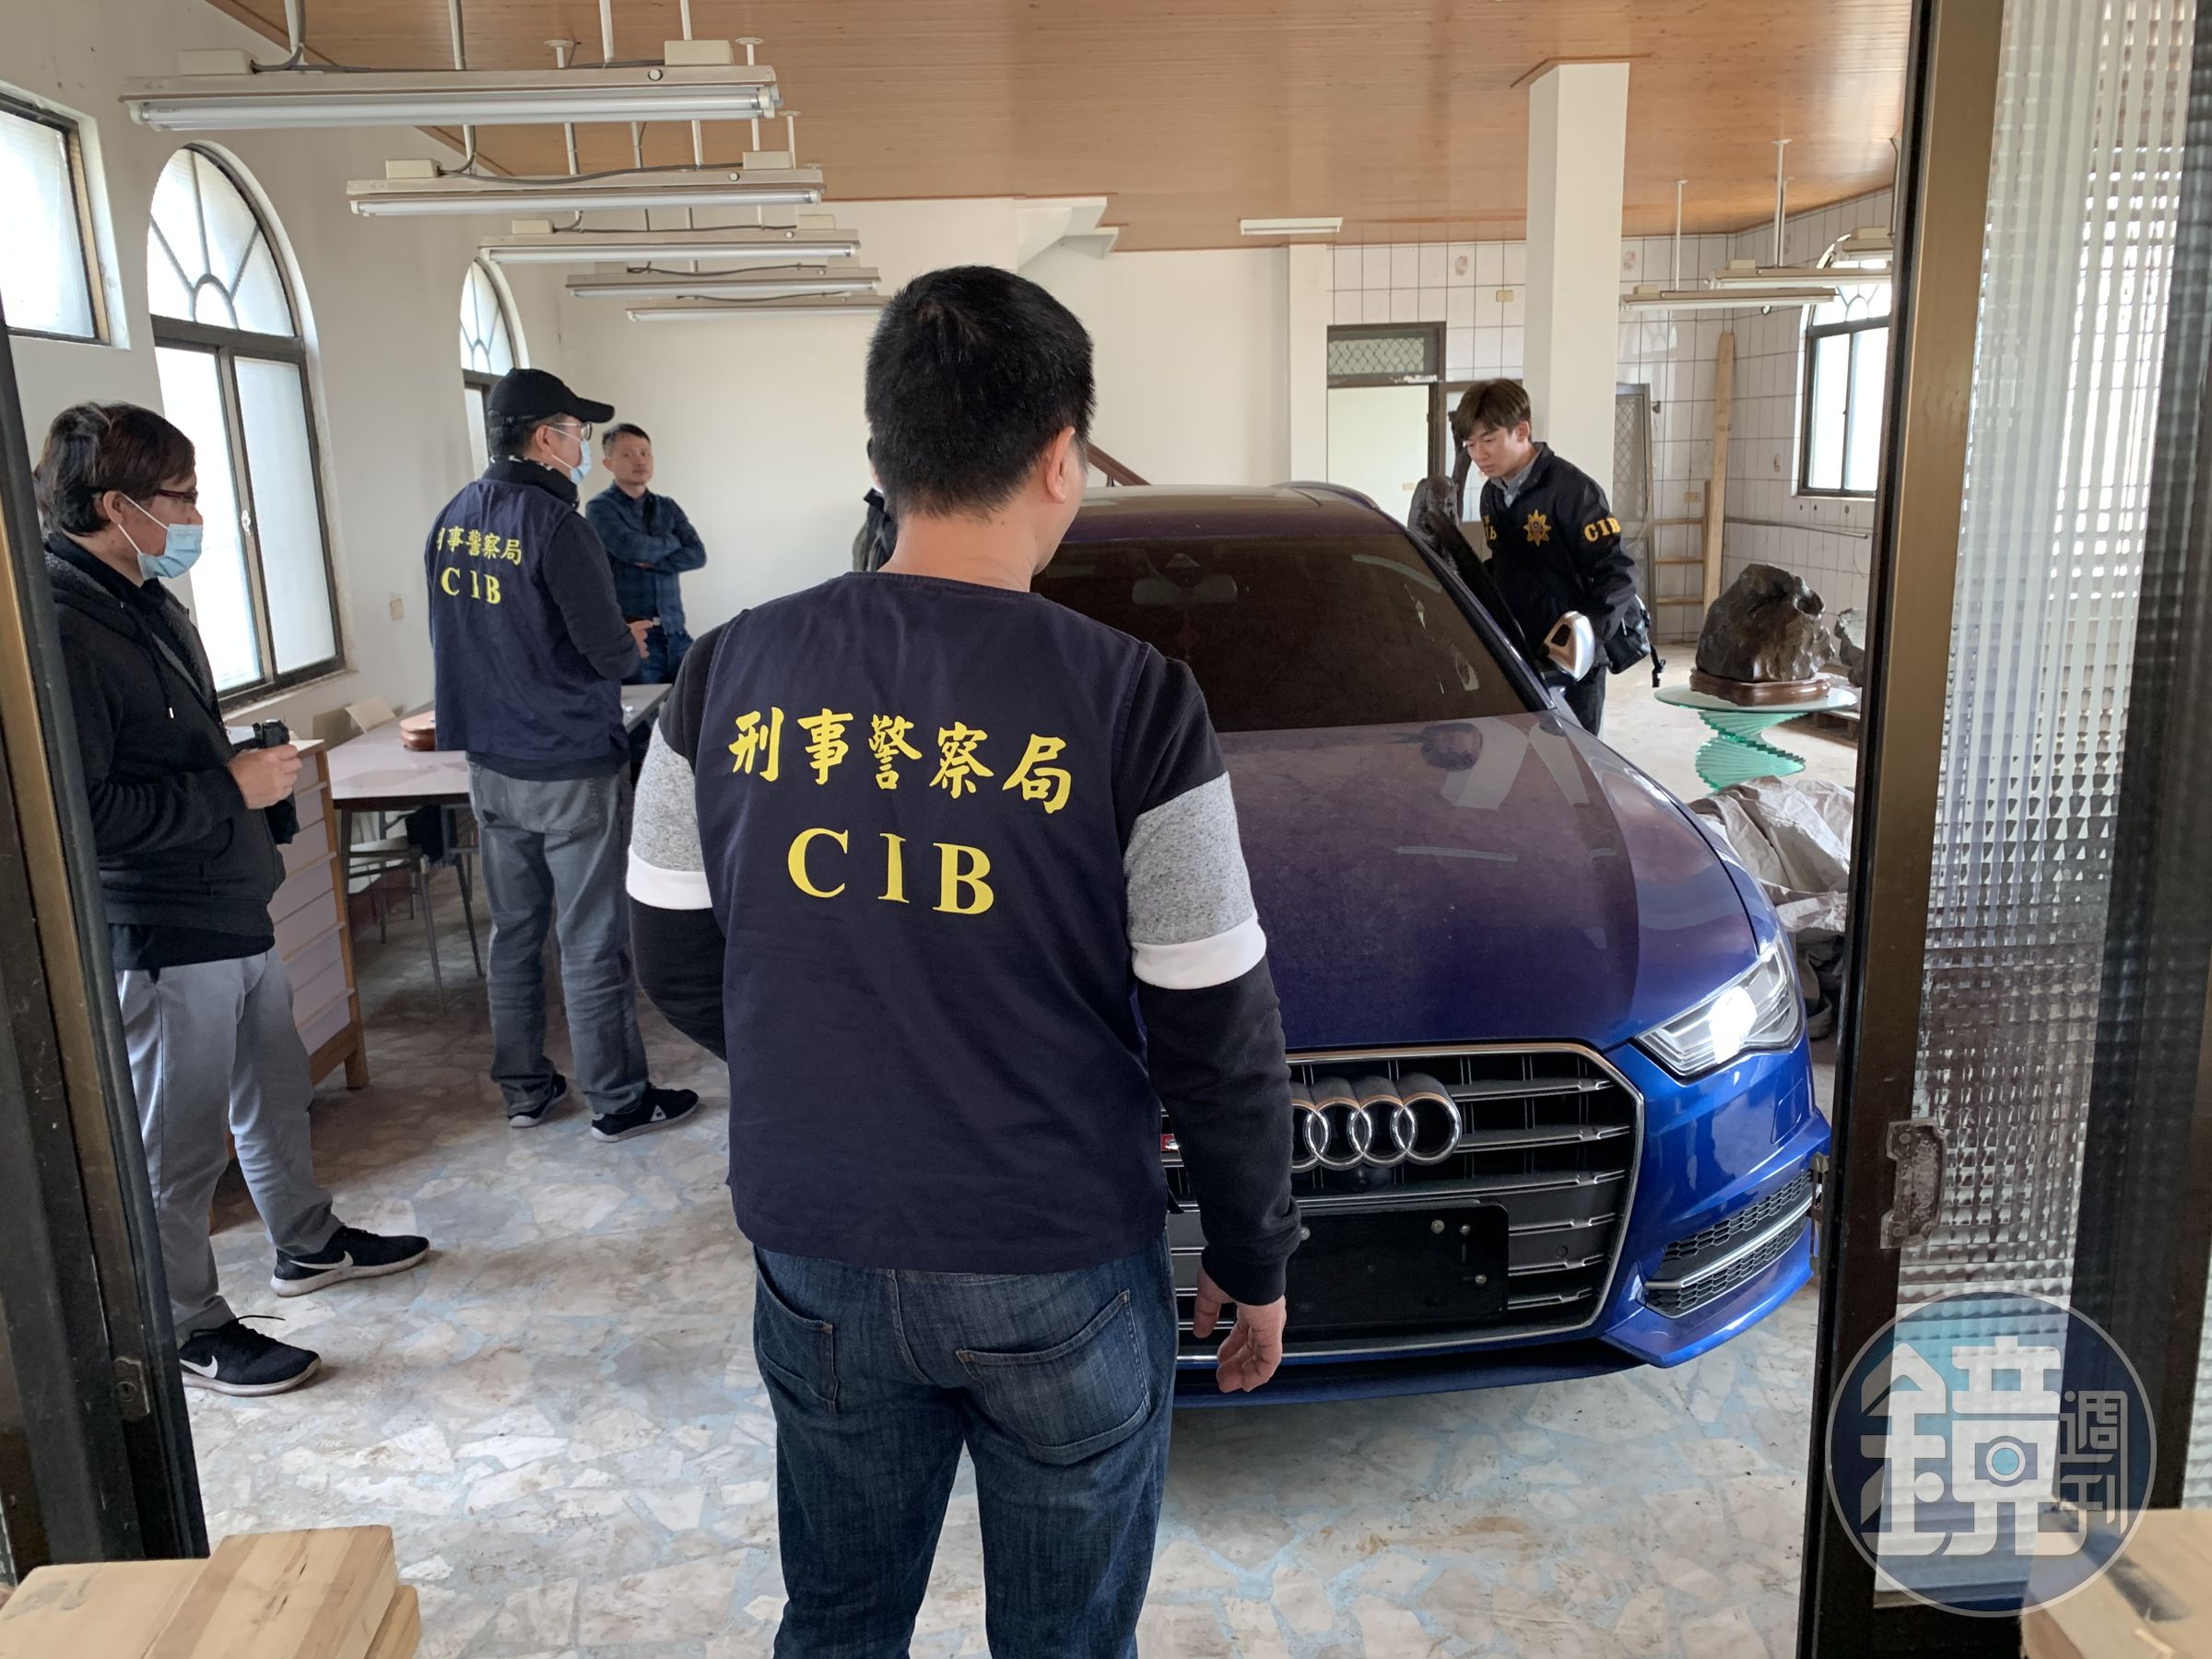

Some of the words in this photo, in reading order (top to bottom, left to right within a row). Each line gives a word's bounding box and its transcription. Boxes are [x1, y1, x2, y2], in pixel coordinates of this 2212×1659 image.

[1584, 516, 1621, 542] CIB
[441, 567, 501, 605] CIB
[728, 706, 1072, 814] 刑事警察局
[787, 827, 994, 915] CIB
